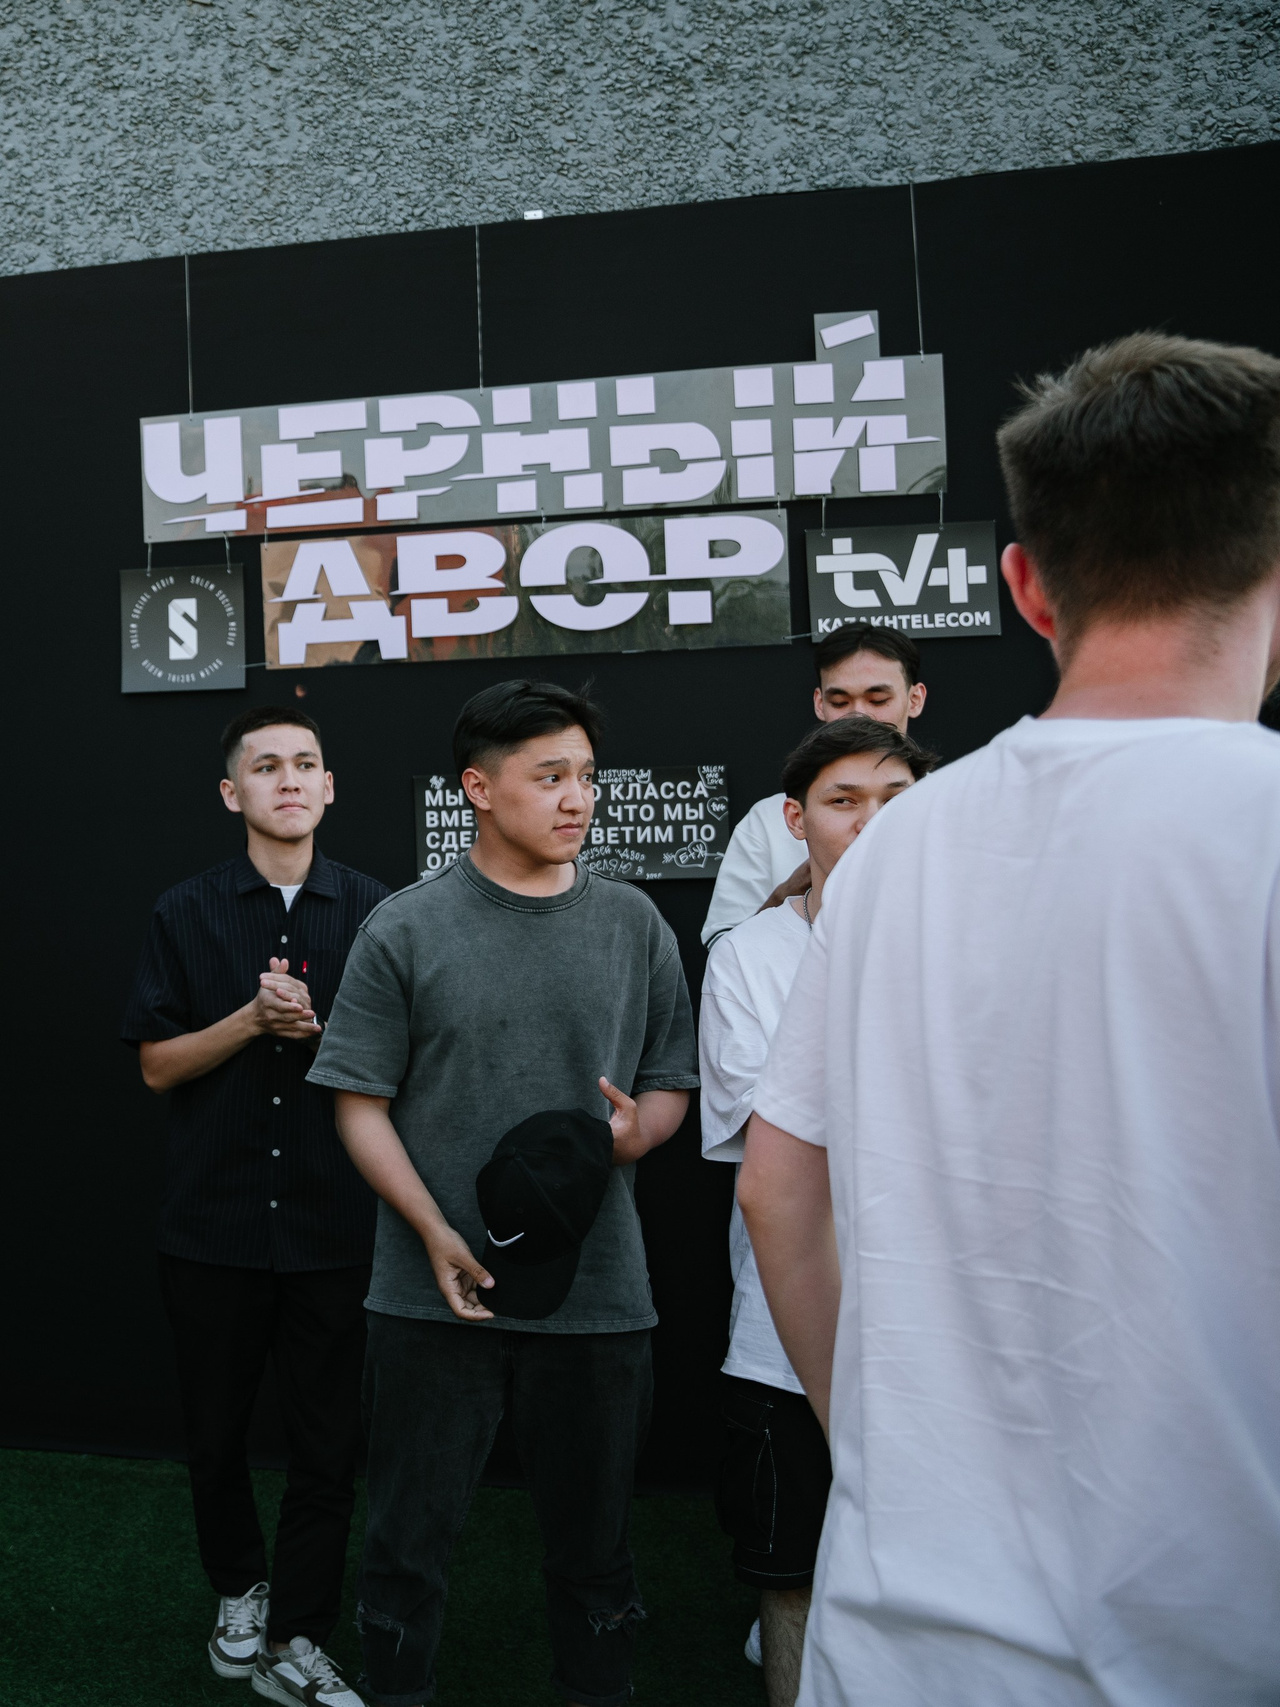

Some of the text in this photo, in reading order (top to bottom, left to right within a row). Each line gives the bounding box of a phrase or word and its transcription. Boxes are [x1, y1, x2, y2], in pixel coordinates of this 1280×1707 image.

[272, 515, 786, 665] ДВОР
[425, 788, 464, 807] МЫ
[610, 780, 709, 801] КЛАССА
[425, 809, 476, 828] ВМЕ
[607, 804, 656, 822] ЧТО
[663, 802, 705, 821] МЫ
[426, 824, 717, 852] СДЕ ВЕТИМ ПО
